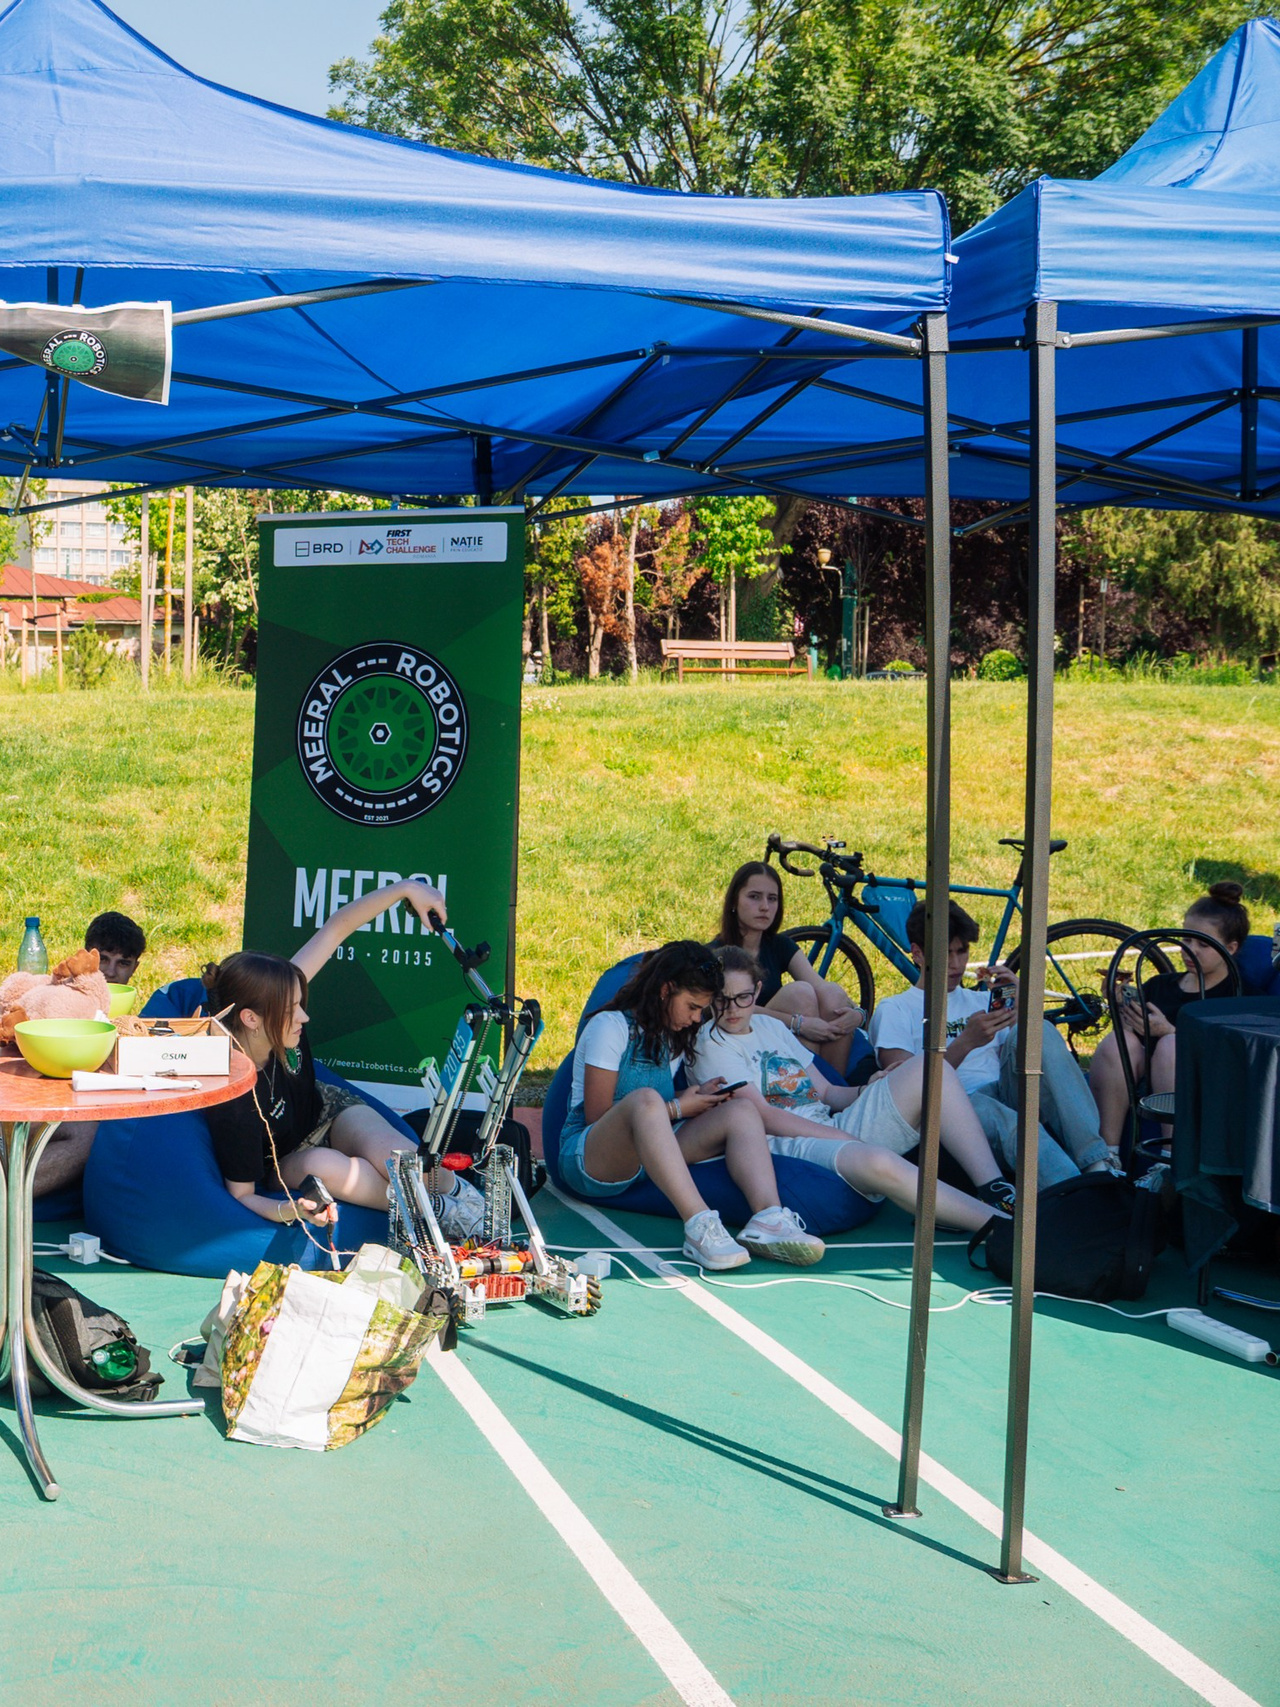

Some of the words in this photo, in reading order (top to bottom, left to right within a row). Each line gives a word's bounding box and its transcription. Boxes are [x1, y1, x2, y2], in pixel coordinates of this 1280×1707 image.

[79, 332, 106, 375] ROBOTICS
[386, 529, 412, 537] FIRST
[312, 543, 344, 554] BRD
[386, 538, 410, 546] TECH
[385, 545, 437, 554] CHALLENGE
[303, 668, 353, 784] MEERAL
[395, 652, 461, 794] ROBOTICS
[381, 948, 432, 966] 20135
